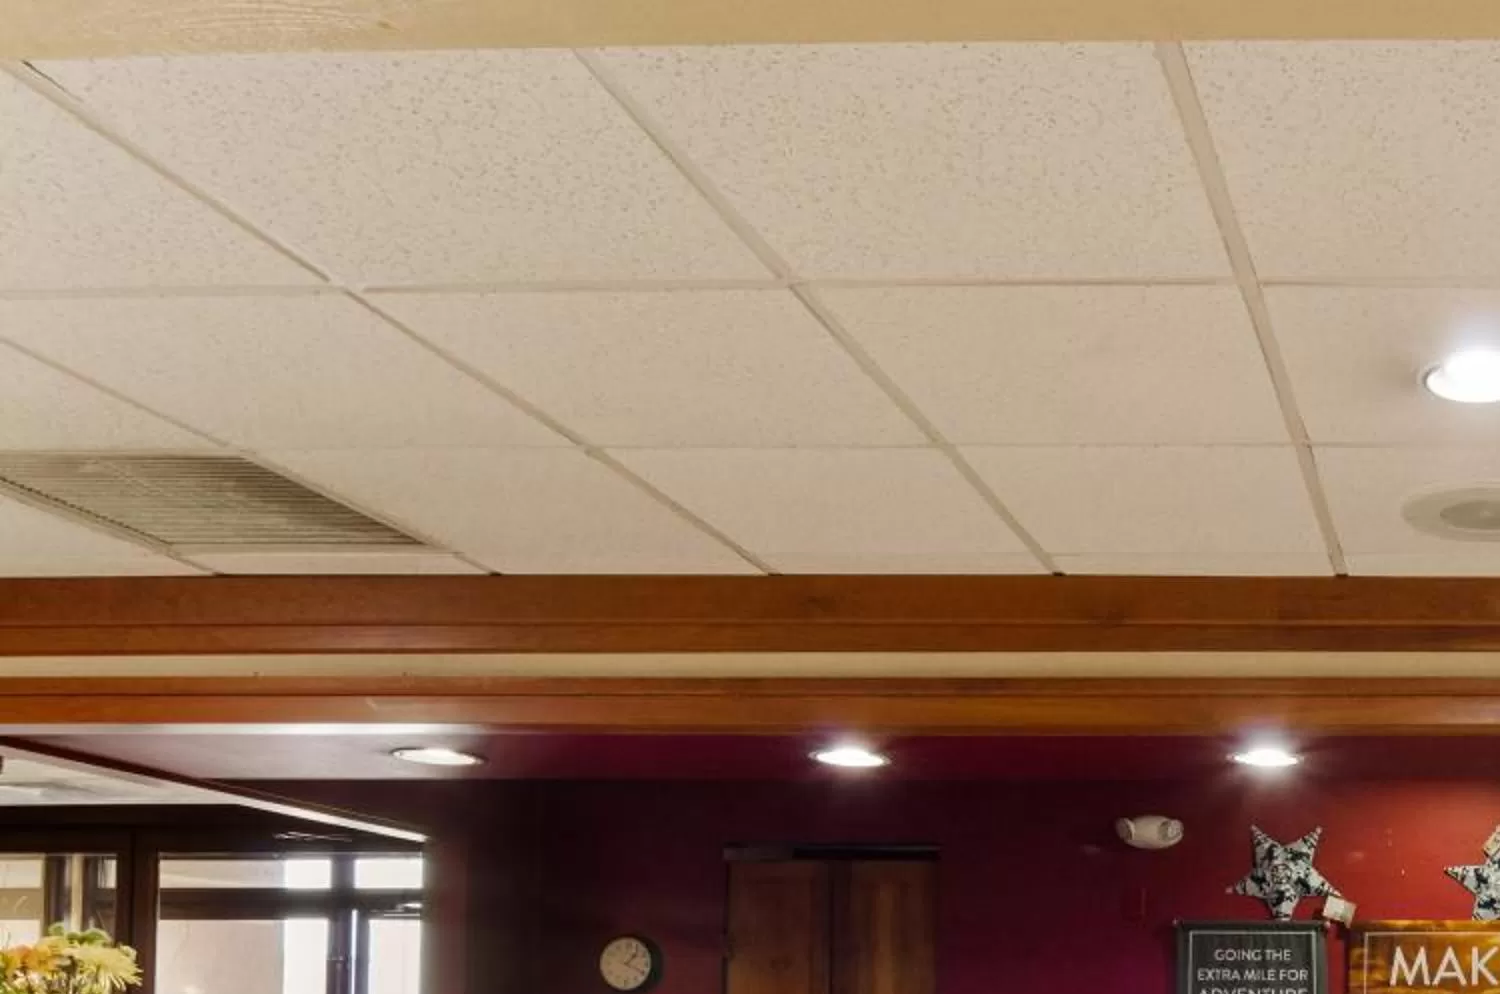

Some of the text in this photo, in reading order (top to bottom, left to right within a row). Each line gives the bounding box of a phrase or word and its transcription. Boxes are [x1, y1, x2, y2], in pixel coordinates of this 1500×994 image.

[1214, 949, 1291, 961] GOING THE
[1197, 969, 1308, 981] EXTRA MILE FOR
